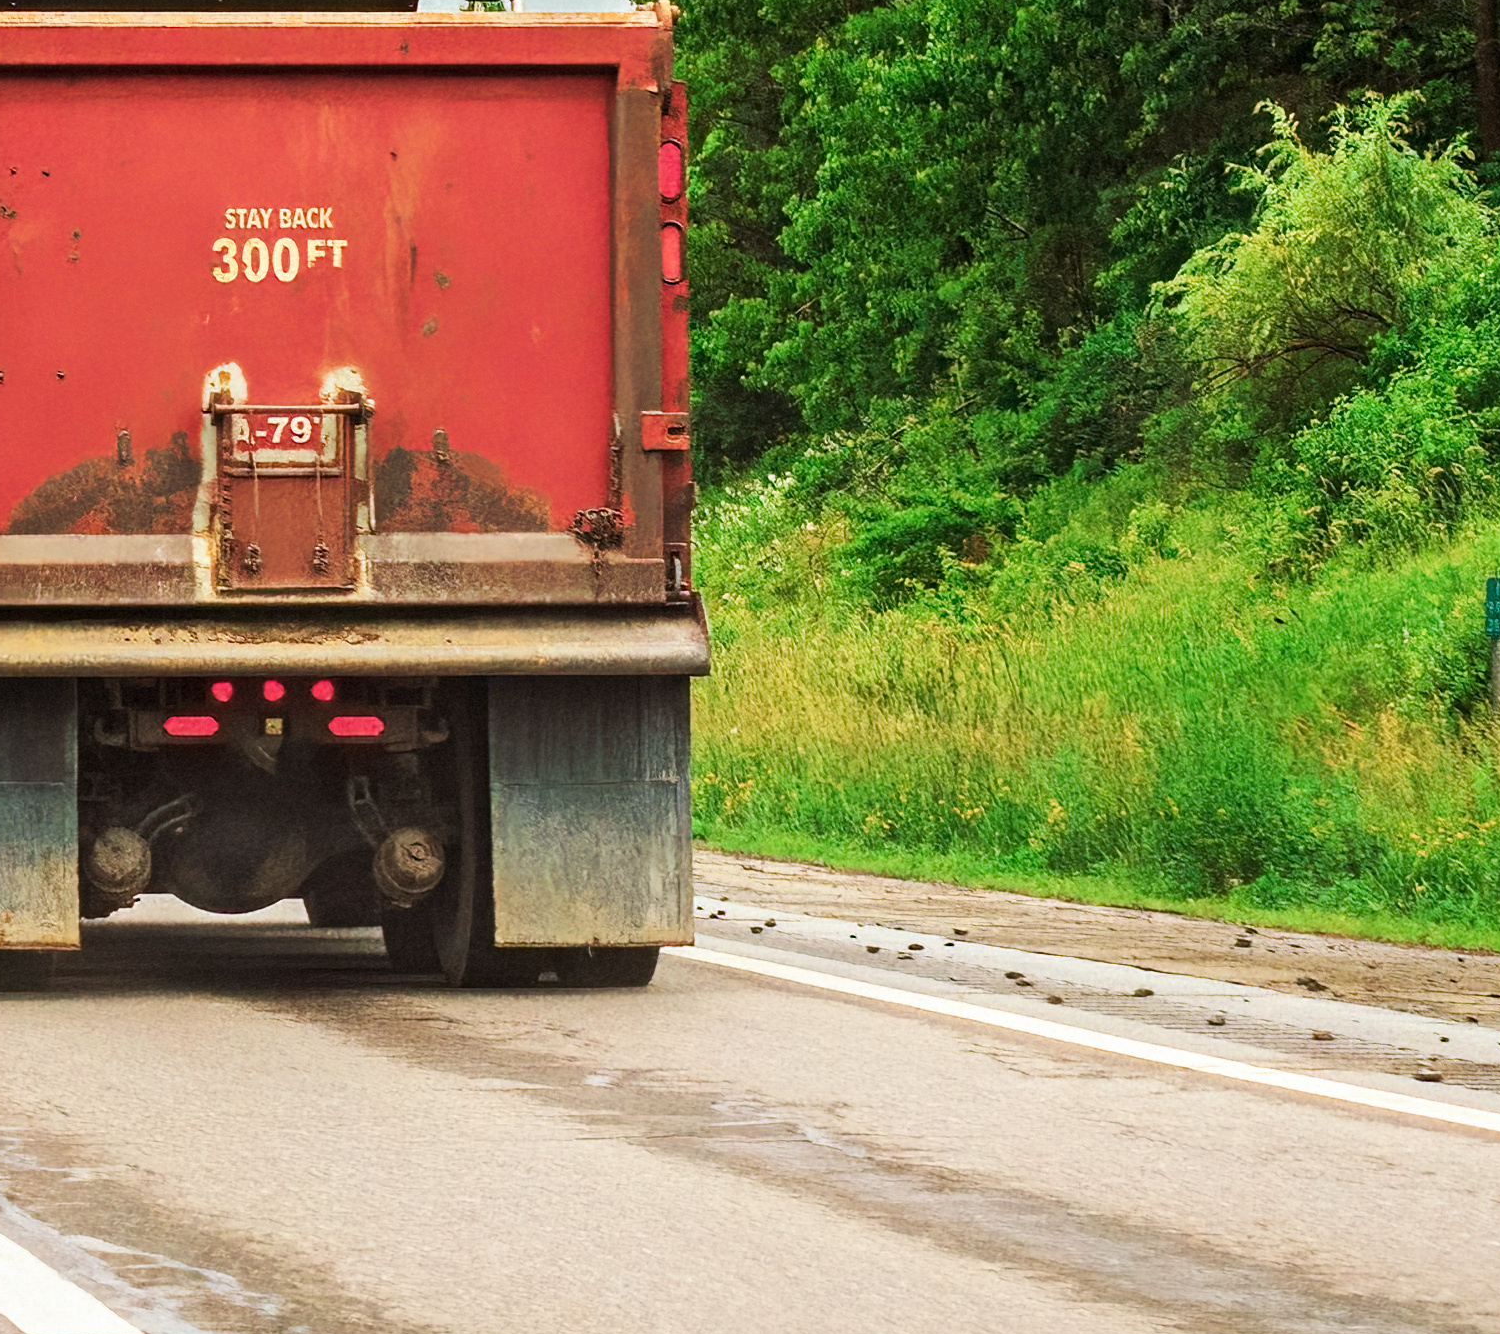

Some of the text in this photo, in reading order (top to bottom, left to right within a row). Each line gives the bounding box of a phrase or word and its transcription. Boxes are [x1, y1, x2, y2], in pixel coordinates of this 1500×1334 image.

[225, 207, 333, 229] STAY BACK
[212, 237, 348, 283] 300 FT
